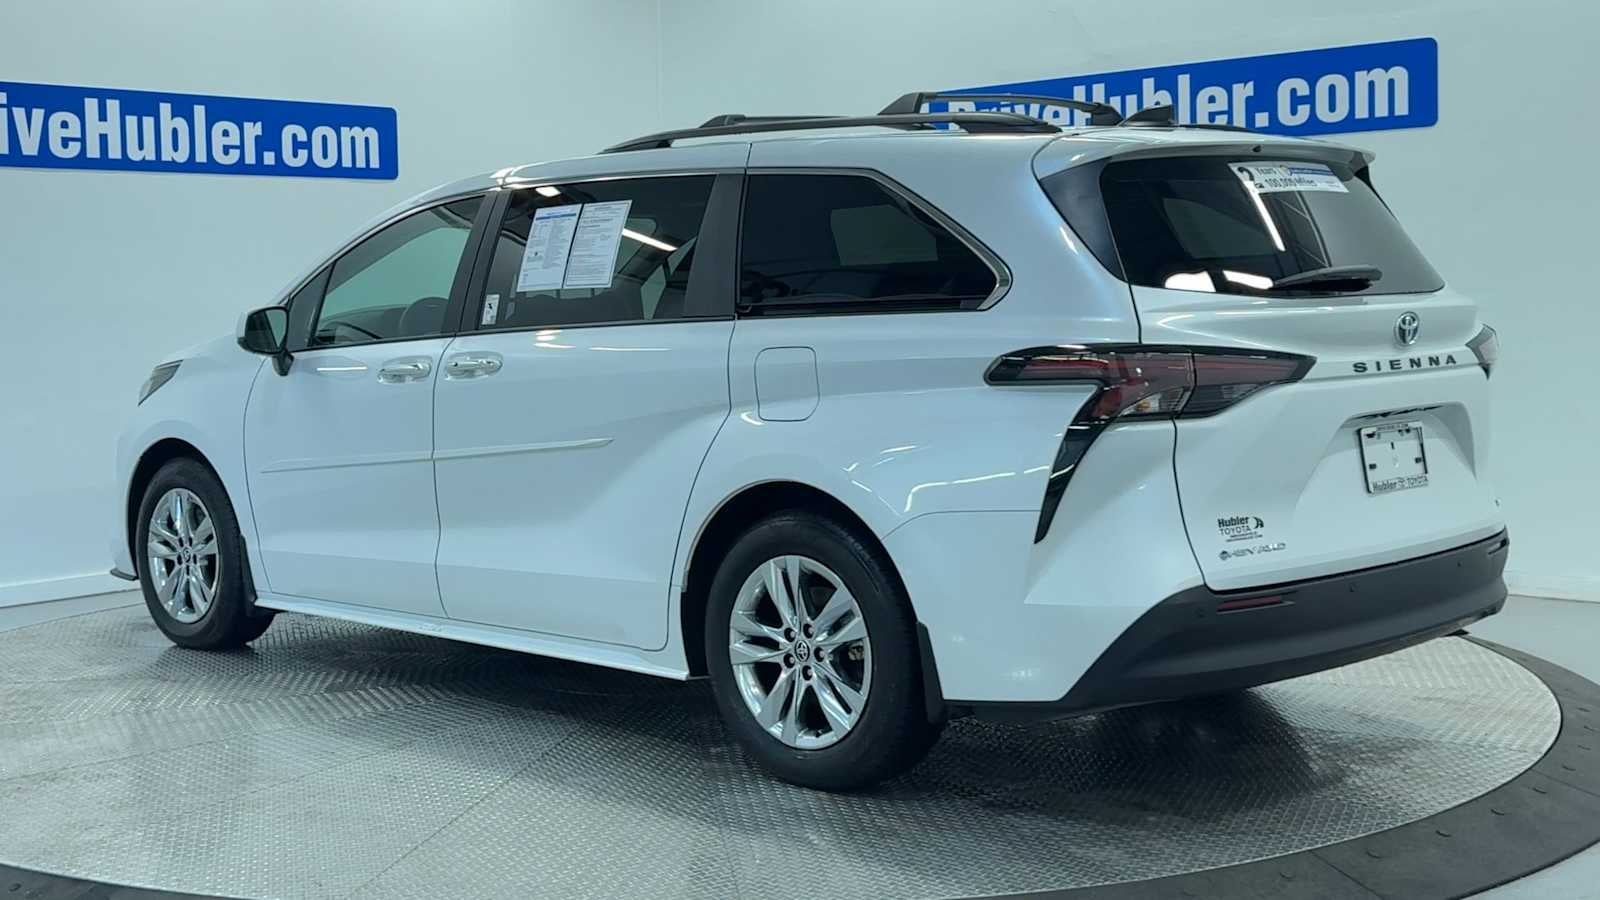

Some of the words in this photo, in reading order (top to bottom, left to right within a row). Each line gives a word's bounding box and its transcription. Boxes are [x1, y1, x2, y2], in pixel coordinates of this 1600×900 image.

[1352, 354, 1457, 374] SIENNA
[1217, 515, 1250, 529] Hubler
[1219, 525, 1252, 536] TOYOTA
